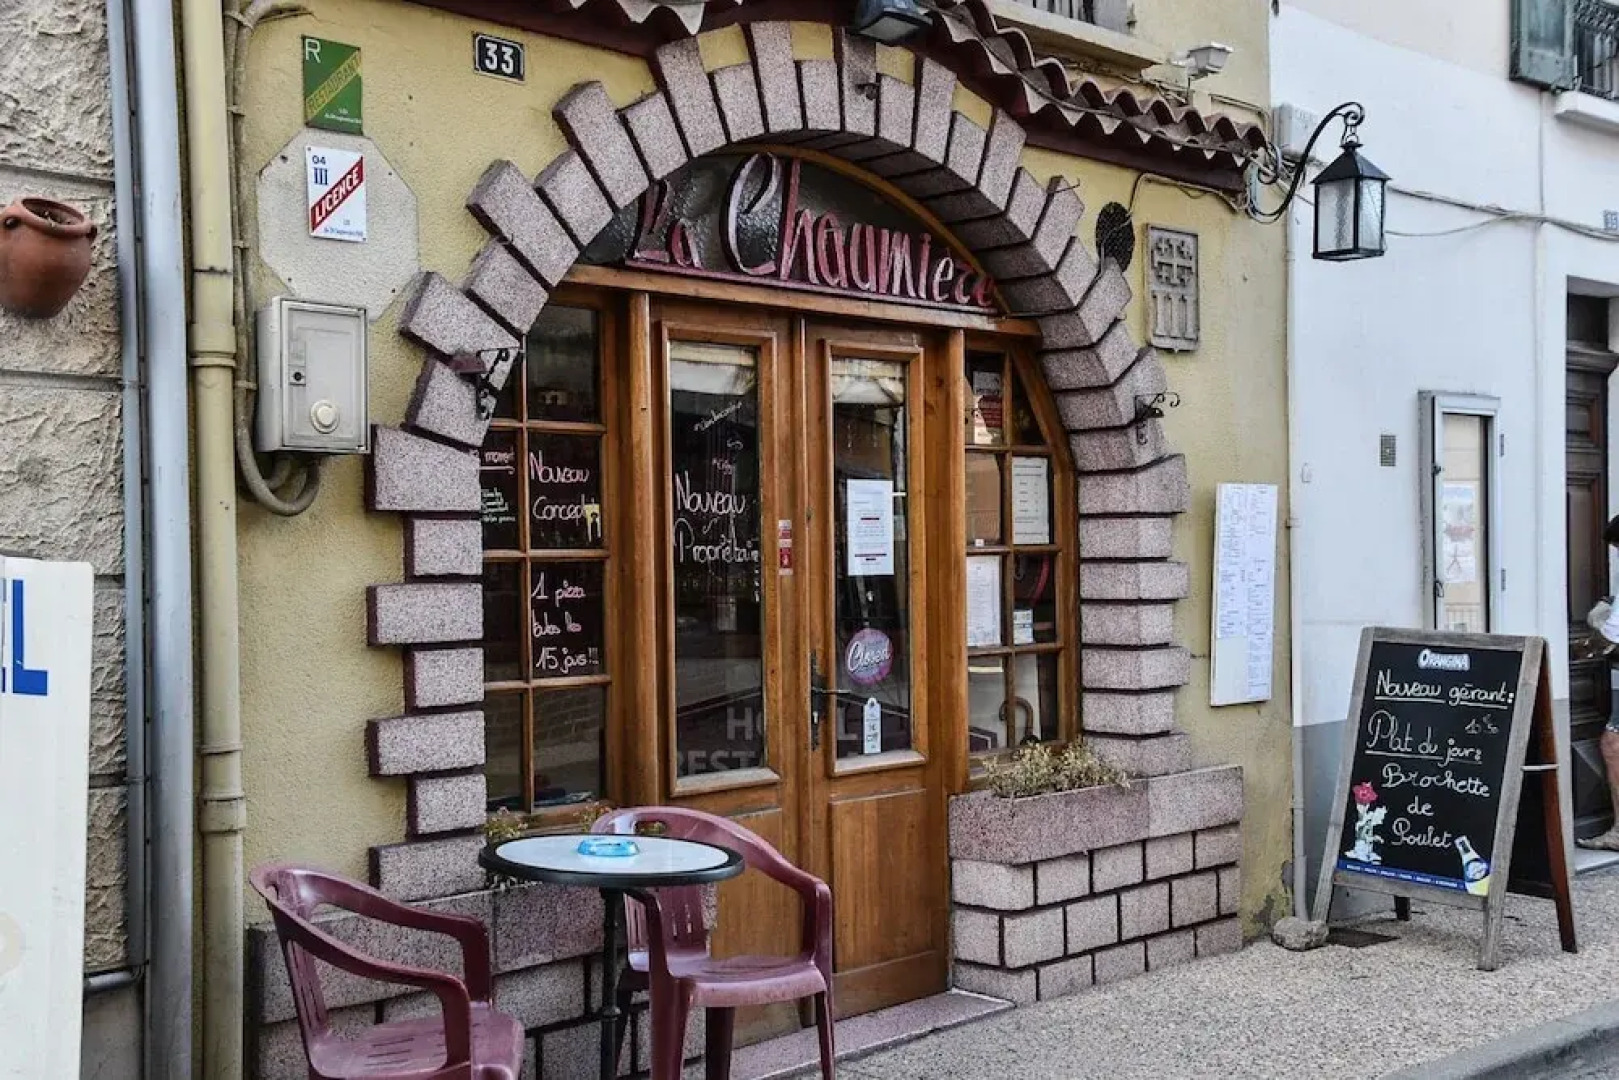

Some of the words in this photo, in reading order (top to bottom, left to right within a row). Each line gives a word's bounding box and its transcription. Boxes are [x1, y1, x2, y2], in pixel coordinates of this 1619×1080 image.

[305, 38, 321, 64] R
[484, 42, 515, 75] 33
[312, 155, 327, 165] 04
[315, 165, 360, 224] LICENCE
[632, 177, 702, 269] La
[1376, 668, 1442, 697] Nouveau
[1366, 709, 1413, 752] Plat
[1418, 726, 1438, 754] du
[1381, 762, 1490, 798] Brochette
[1407, 796, 1434, 817] de
[1392, 817, 1452, 849] Poulet
